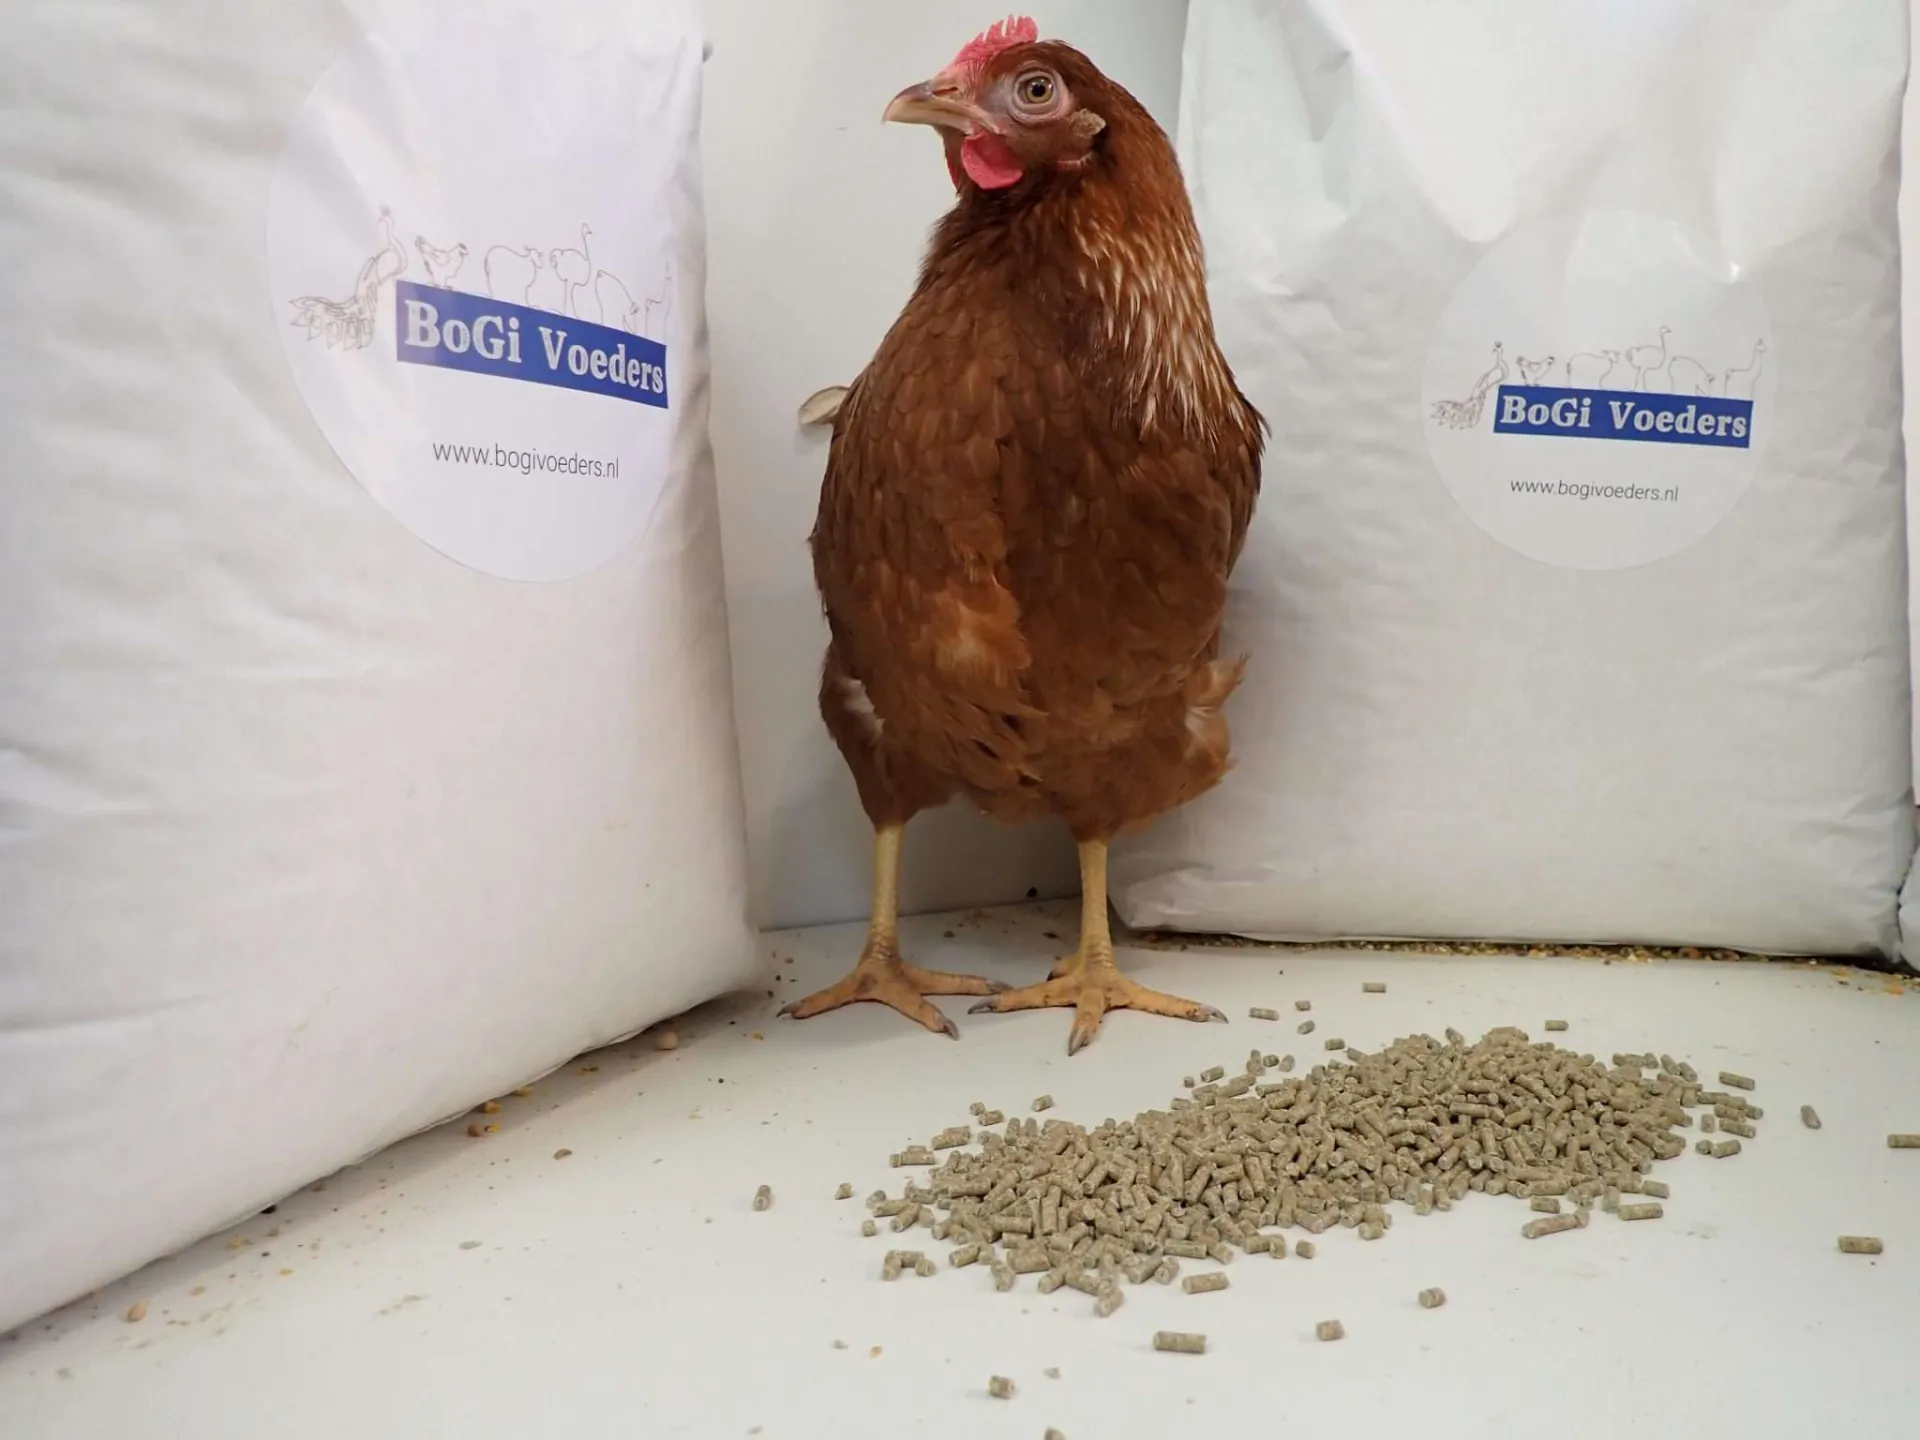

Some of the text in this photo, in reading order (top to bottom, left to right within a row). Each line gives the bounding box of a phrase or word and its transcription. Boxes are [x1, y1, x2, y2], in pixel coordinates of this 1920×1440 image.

[404, 299, 665, 395] BoGi Voeders
[1500, 394, 1748, 438] BoGi Voeders
[432, 442, 620, 480] www.bogivoeders.nl
[1510, 479, 1679, 502] www.bogivoeders.nl
